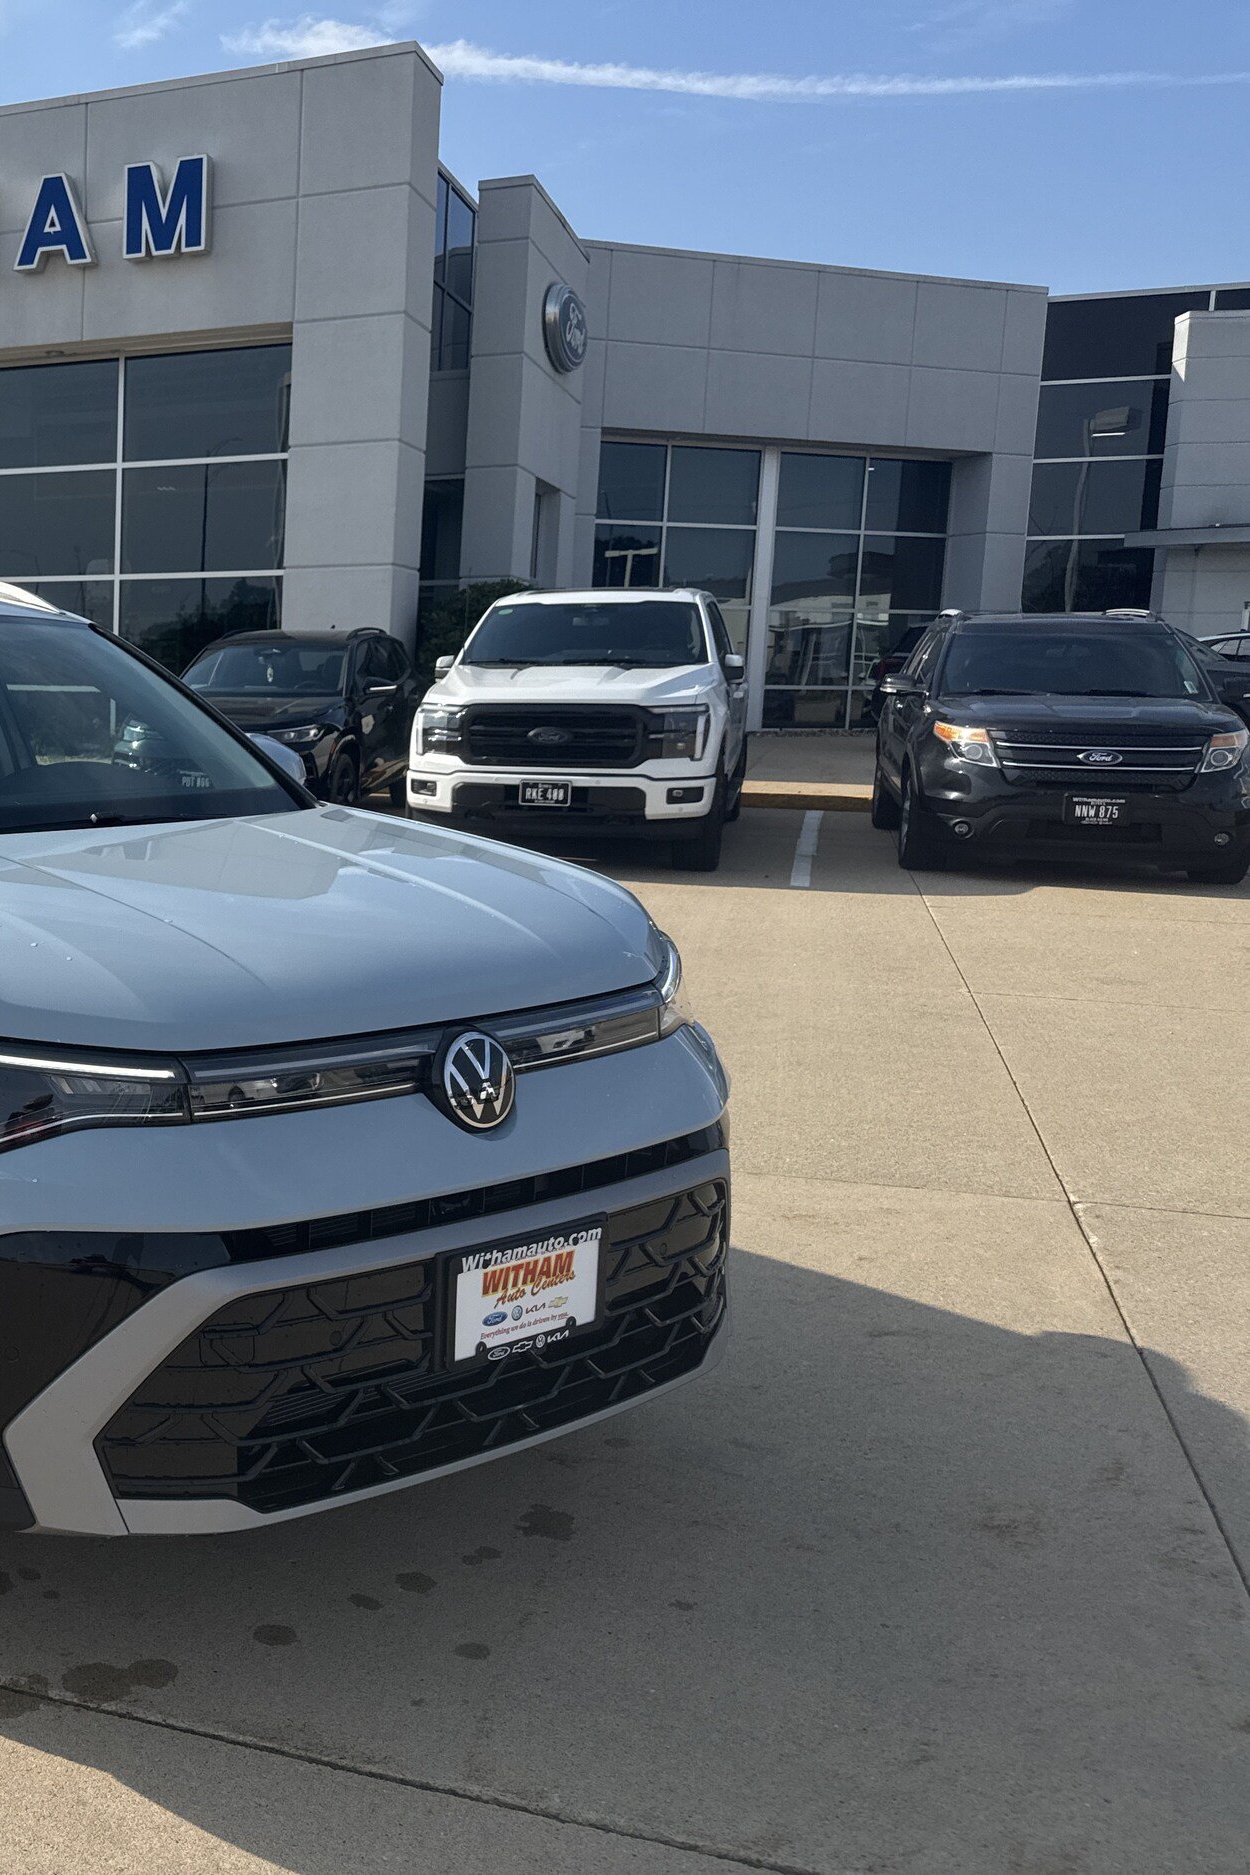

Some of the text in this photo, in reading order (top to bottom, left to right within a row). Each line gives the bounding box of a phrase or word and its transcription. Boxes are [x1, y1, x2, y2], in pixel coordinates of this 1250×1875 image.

[1088, 752, 1114, 762] Ford
[1075, 805, 1119, 818] NNW 875
[481, 1249, 576, 1296] WITHAM
[493, 1269, 576, 1309] Auto Centers
[480, 1326, 511, 1340] Everything
